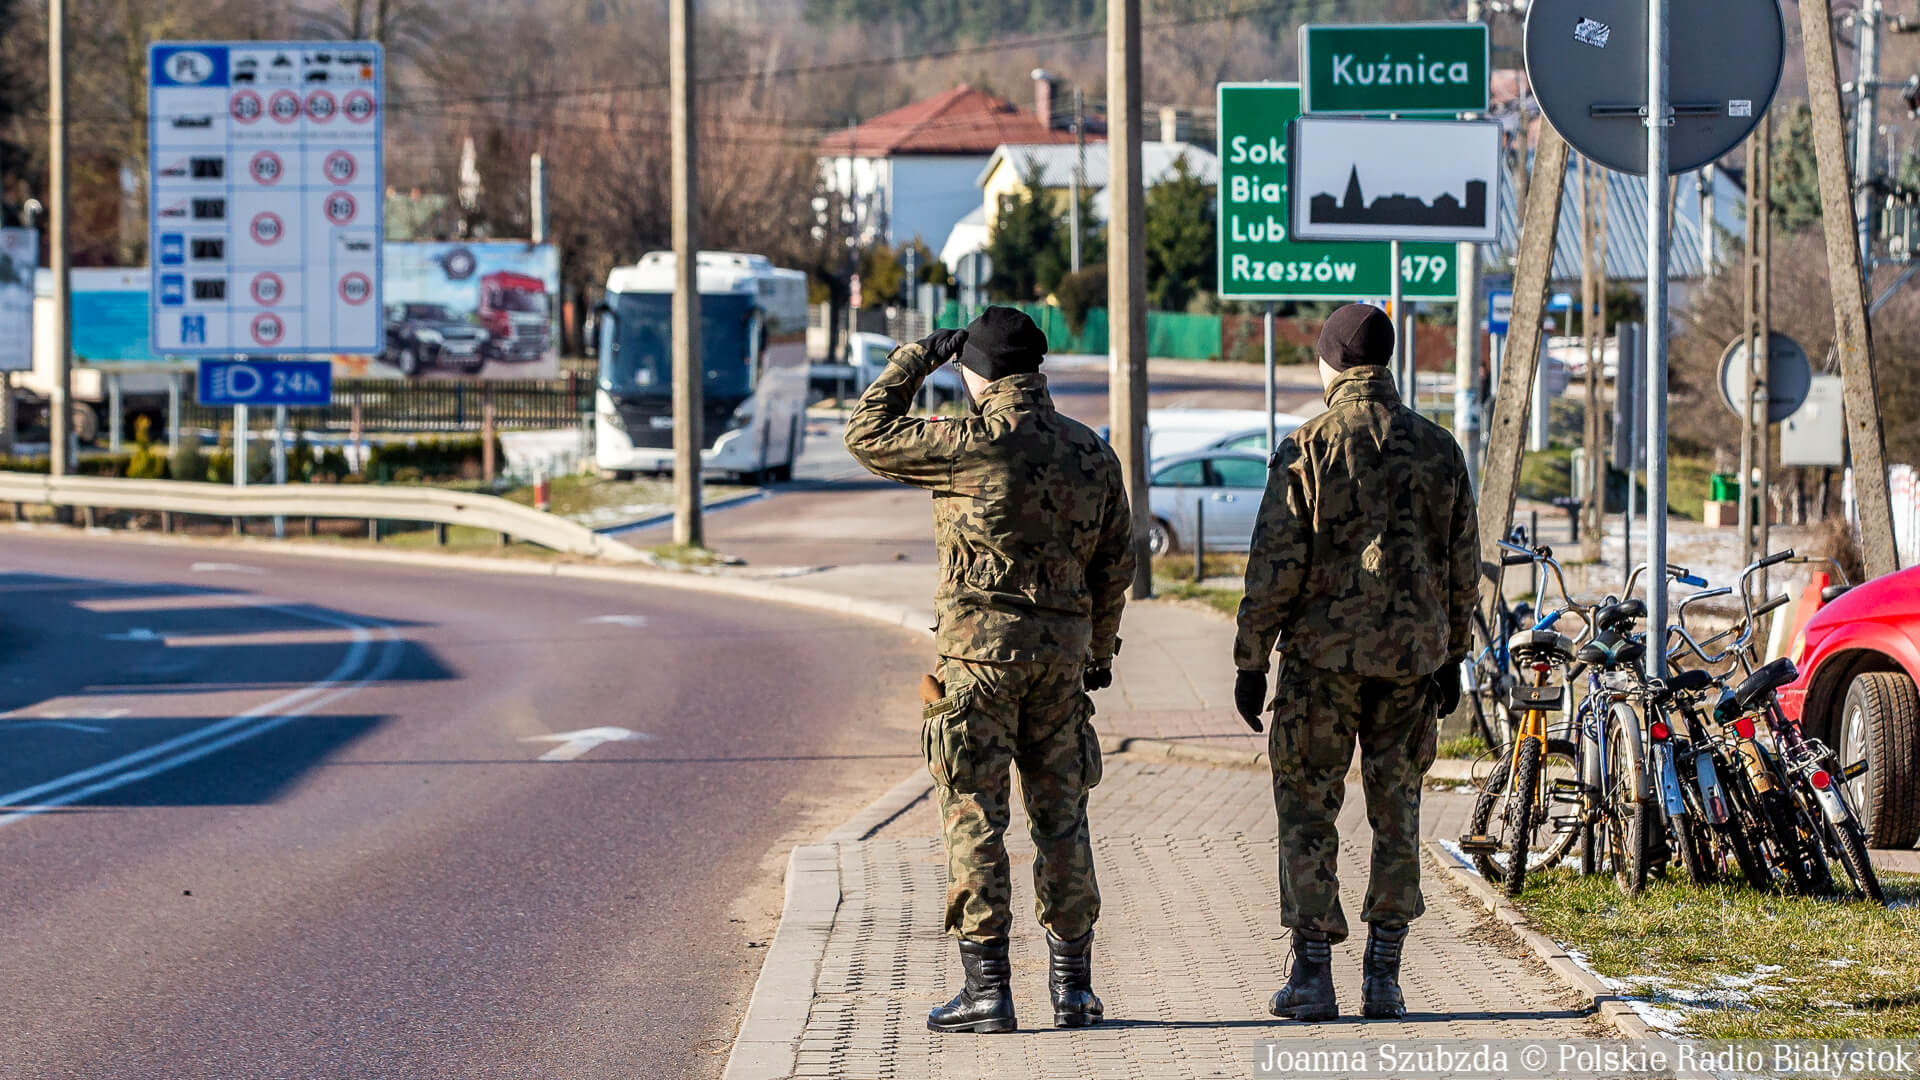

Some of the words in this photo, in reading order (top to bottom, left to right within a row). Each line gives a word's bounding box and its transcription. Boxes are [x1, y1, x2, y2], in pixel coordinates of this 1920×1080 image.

[175, 54, 203, 81] PL
[1332, 53, 1469, 86] Kuźnica
[330, 158, 350, 177] 70
[331, 200, 350, 217] 80
[1231, 214, 1286, 243] Lub
[1231, 253, 1356, 282] Rzeszów
[272, 371, 320, 395] 24h
